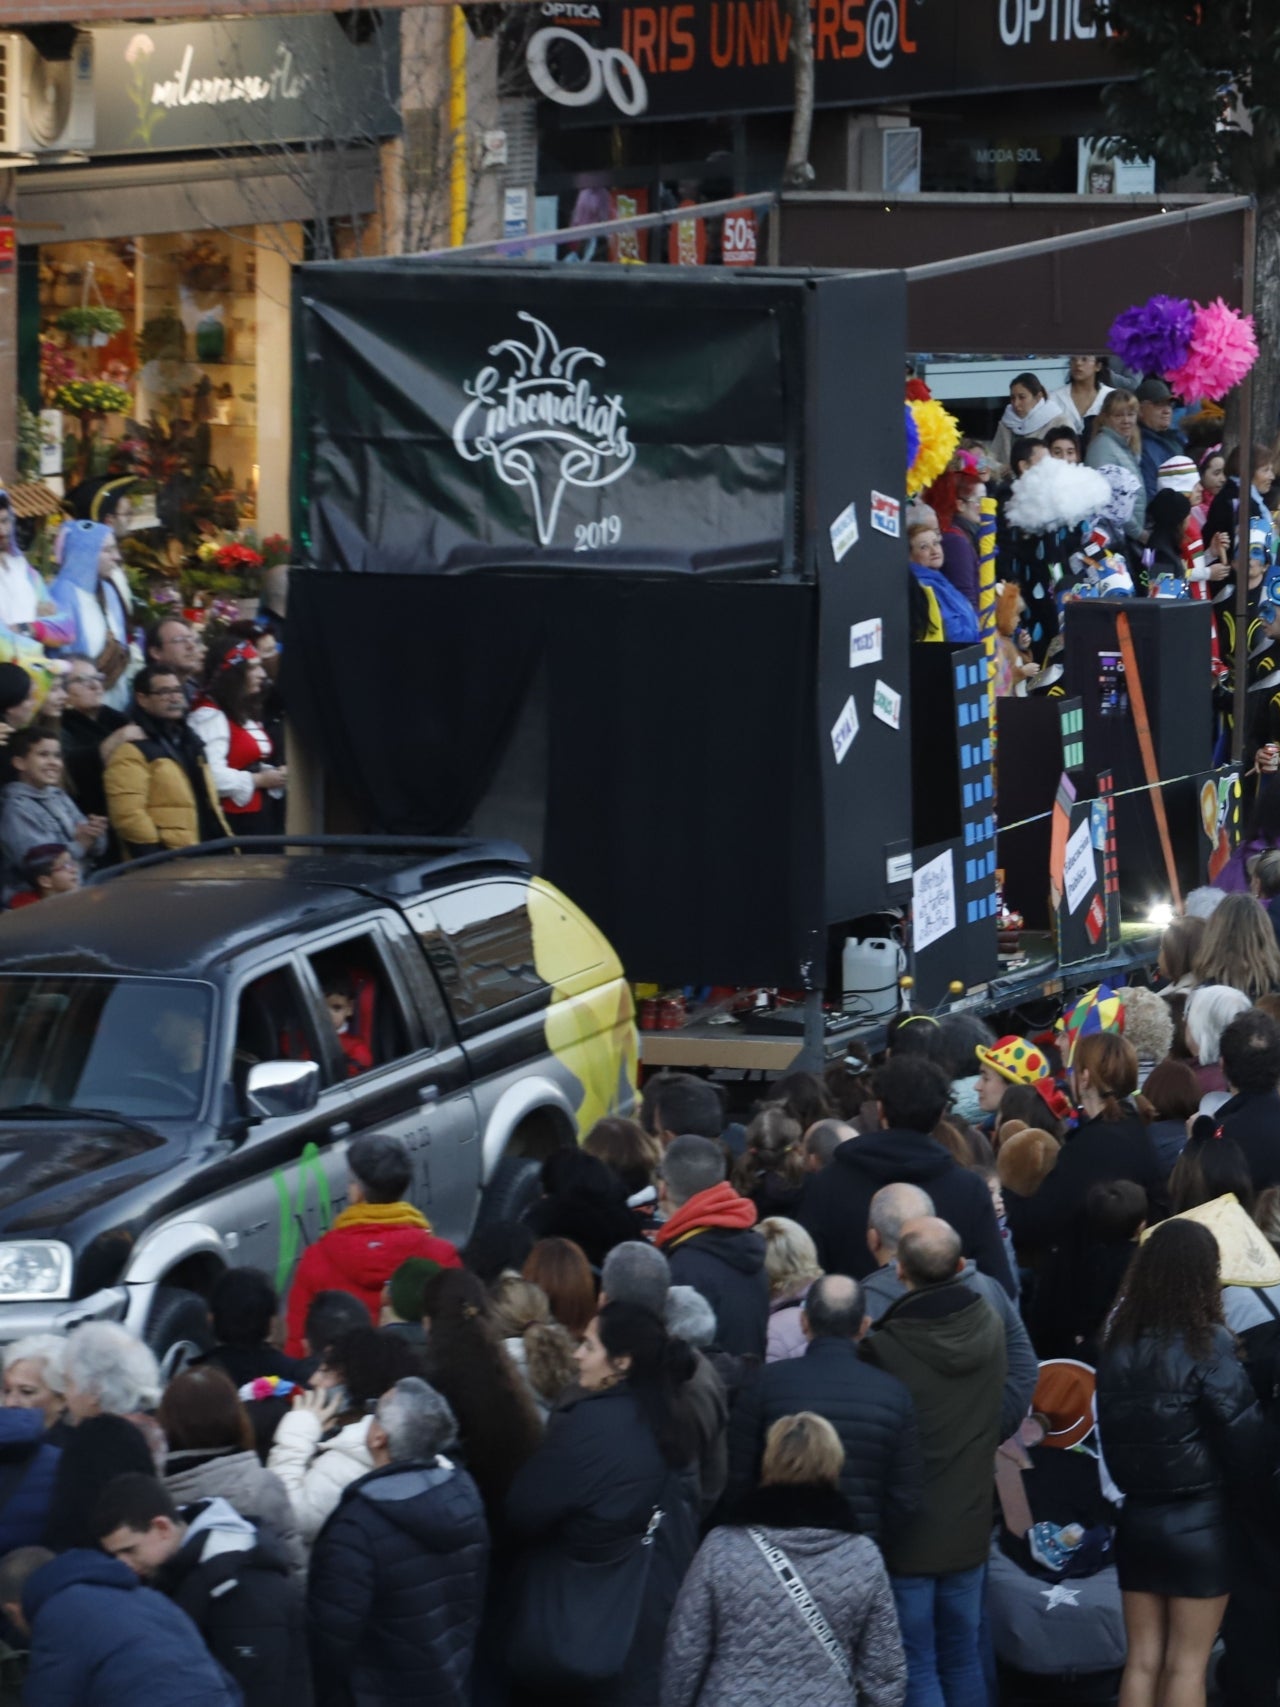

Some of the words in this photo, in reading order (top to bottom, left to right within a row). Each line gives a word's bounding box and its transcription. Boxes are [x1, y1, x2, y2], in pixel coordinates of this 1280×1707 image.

[621, 6, 695, 74] IRIS
[709, 0, 917, 68] UNIVRS@L
[976, 149, 1014, 163] MODA
[1017, 148, 1041, 162] SOL
[724, 217, 756, 250] 50%
[574, 515, 622, 552] 2019
